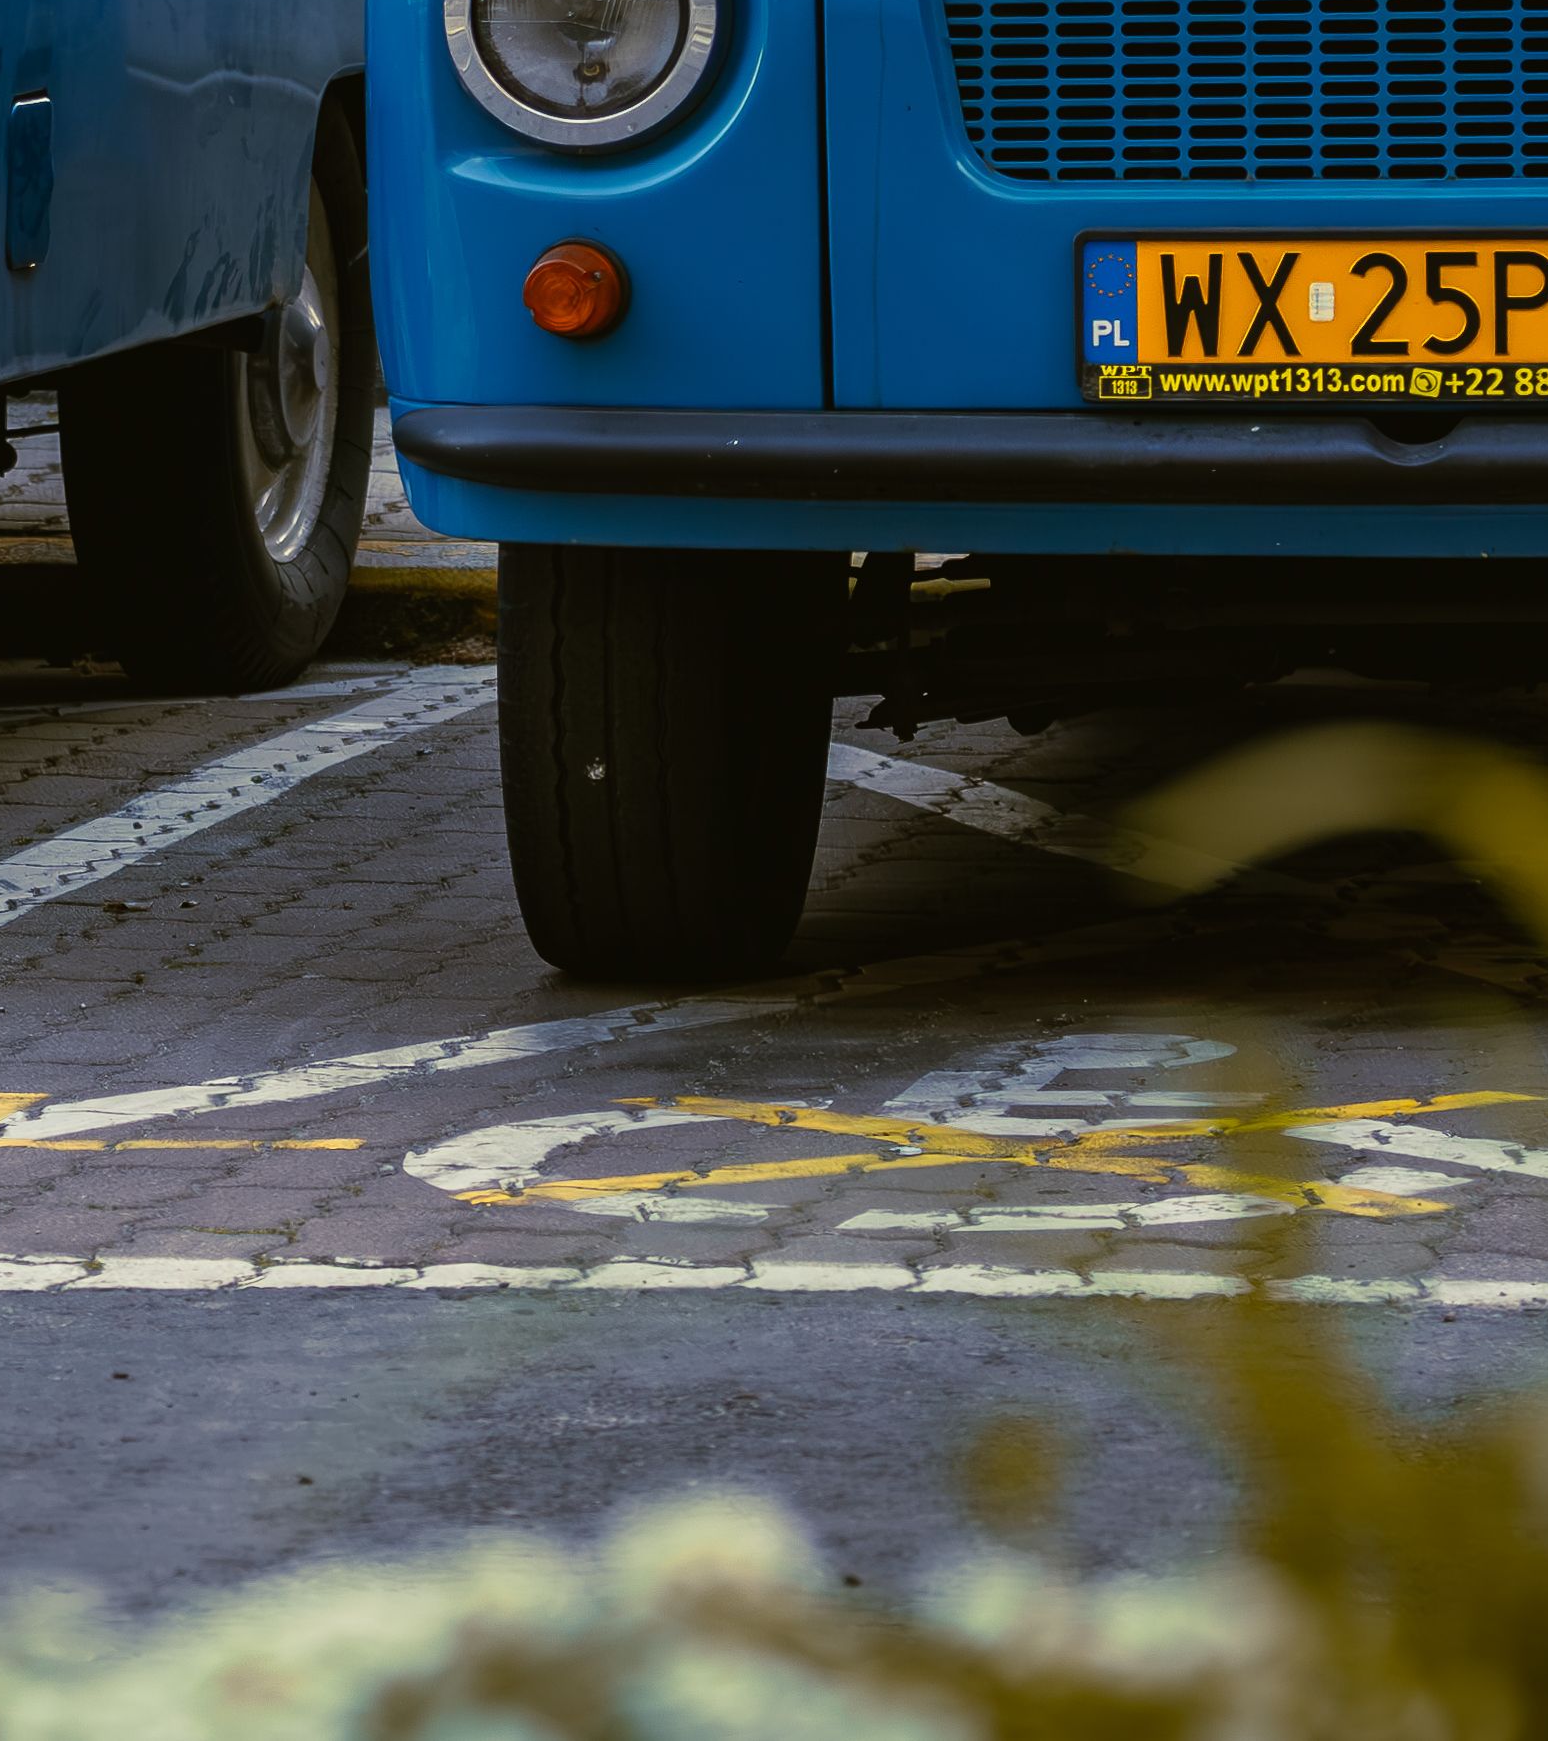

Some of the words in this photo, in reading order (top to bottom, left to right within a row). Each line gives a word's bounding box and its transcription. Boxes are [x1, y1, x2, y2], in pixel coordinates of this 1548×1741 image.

[1092, 319, 1130, 347] PL
[1160, 251, 1301, 357] WX
[1100, 365, 1152, 377] WPT
[1160, 367, 1406, 398] www.wpt1313.com
[1445, 368, 1504, 396] +22
[1111, 379, 1138, 396] 1313
